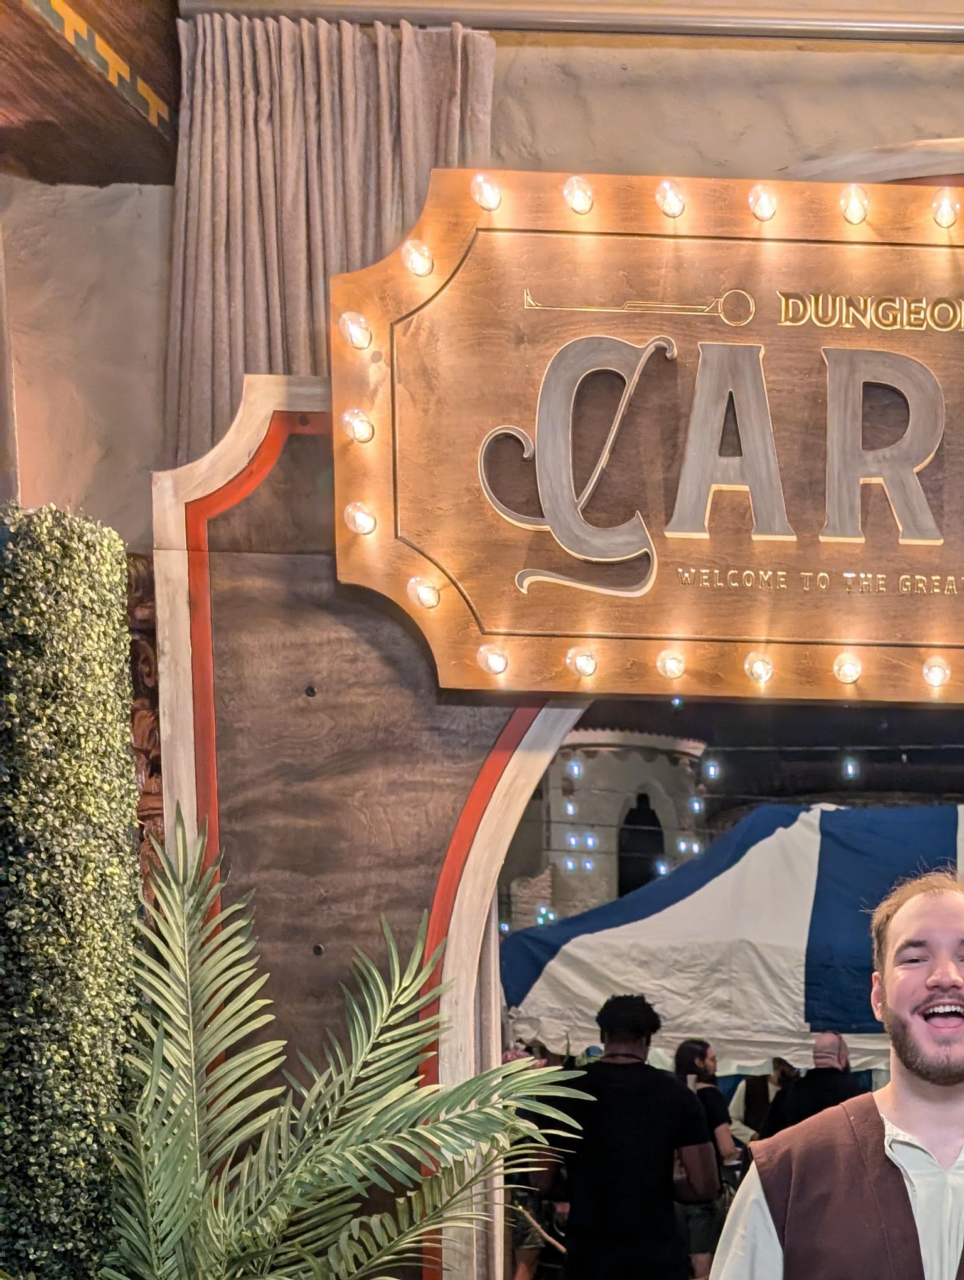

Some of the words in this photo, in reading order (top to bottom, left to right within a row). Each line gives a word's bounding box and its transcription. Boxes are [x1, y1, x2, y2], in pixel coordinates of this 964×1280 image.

[677, 567, 788, 591] WELCOME
[800, 572, 831, 592] TO
[843, 572, 887, 595] THE
